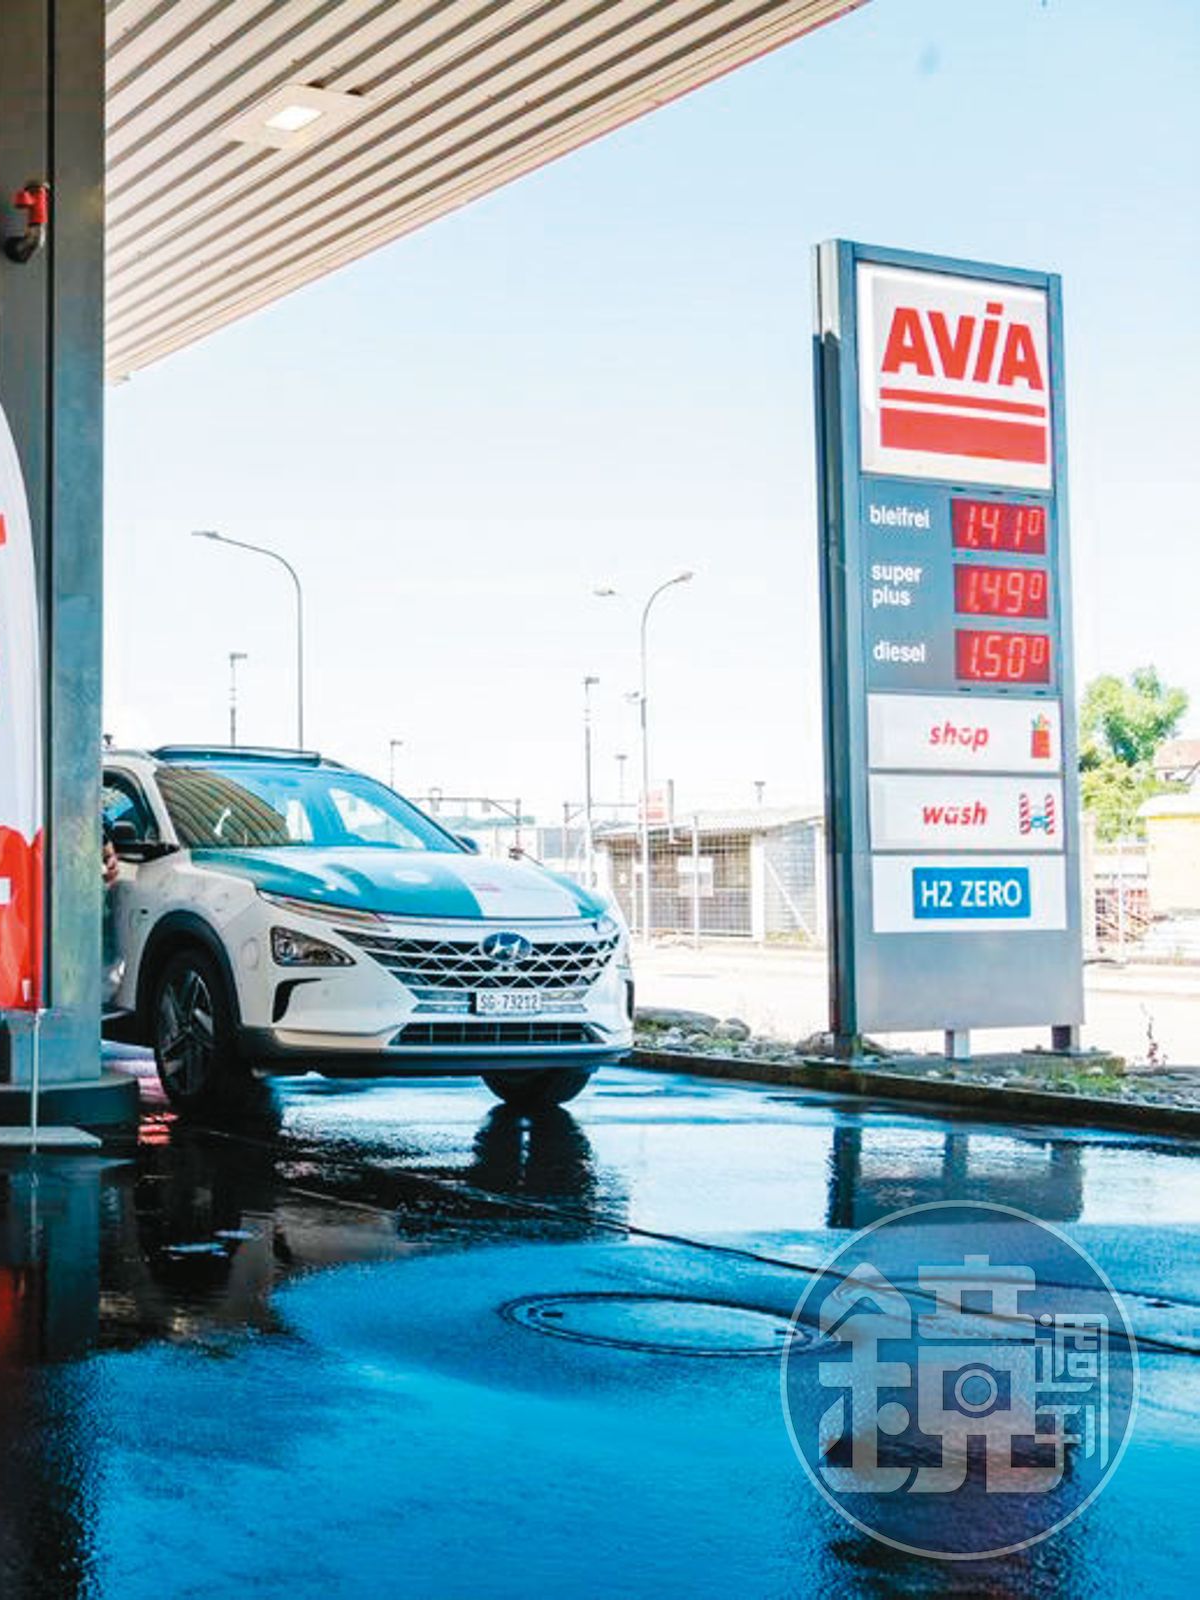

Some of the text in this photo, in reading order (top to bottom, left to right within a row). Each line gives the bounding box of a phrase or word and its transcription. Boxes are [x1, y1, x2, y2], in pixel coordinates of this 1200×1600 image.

[869, 504, 931, 529] bleifrei
[871, 564, 923, 586] super
[872, 585, 912, 609] plus
[872, 640, 926, 663] diesel
[929, 720, 990, 752] shop
[922, 800, 988, 825] wash
[921, 879, 1023, 908] H2 ZERO
